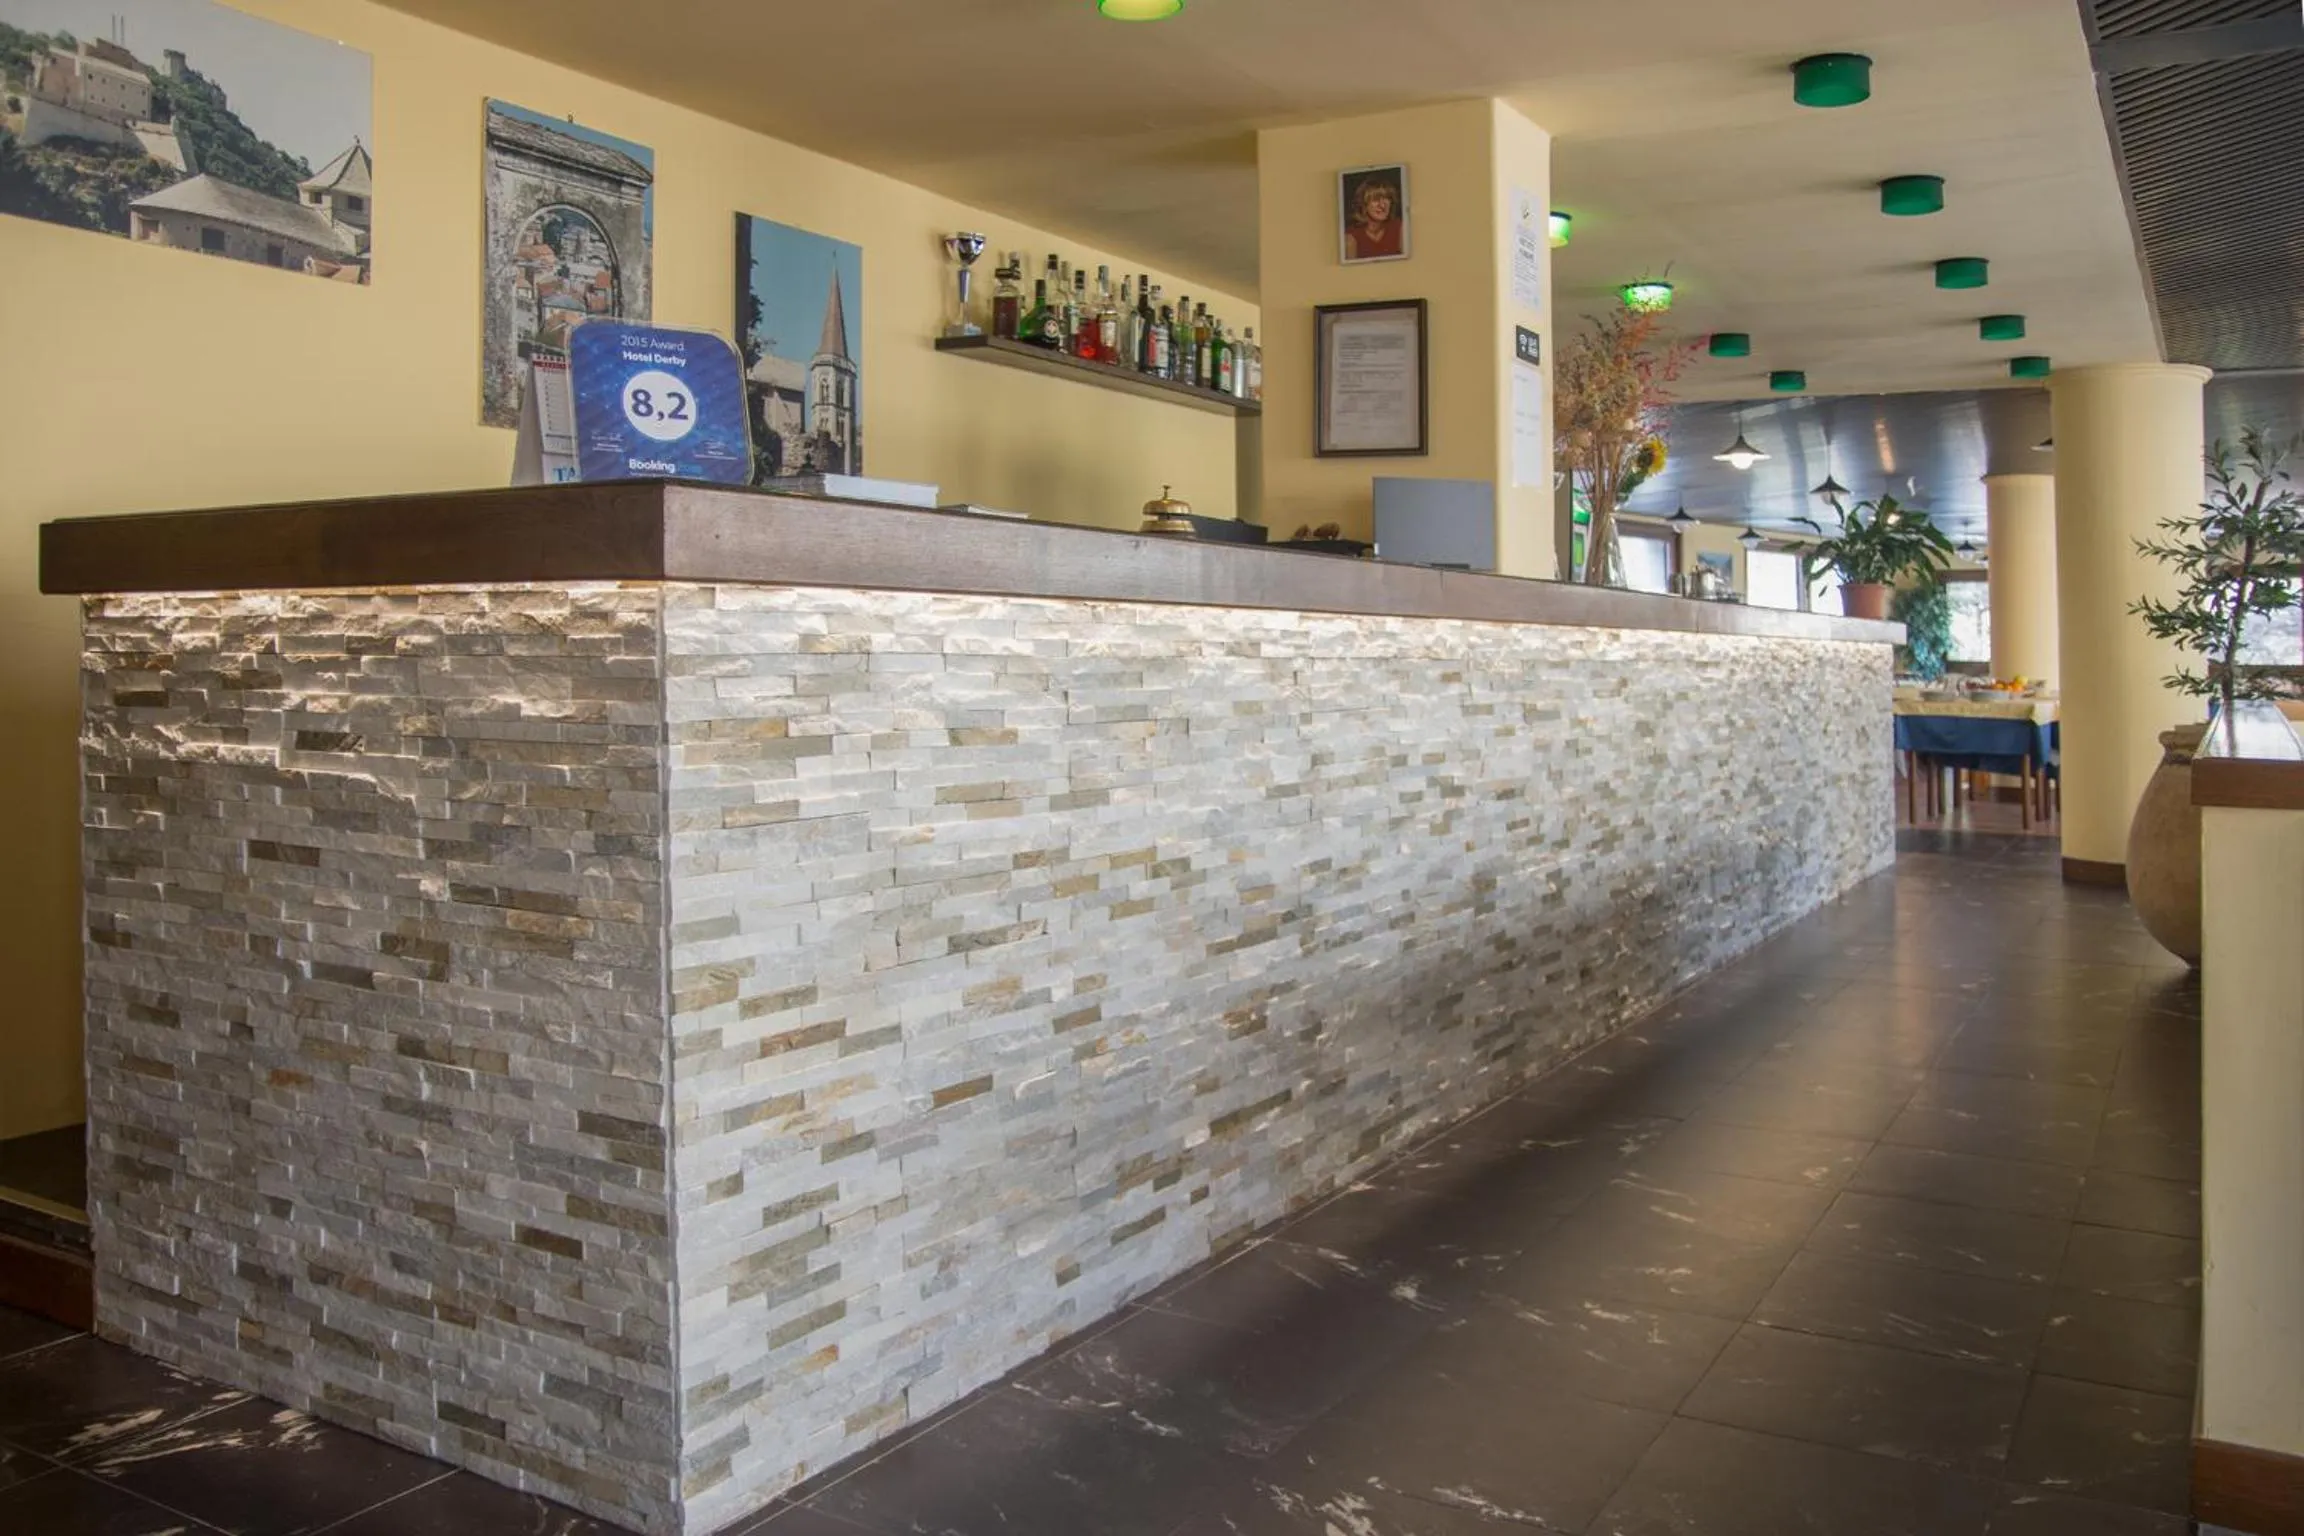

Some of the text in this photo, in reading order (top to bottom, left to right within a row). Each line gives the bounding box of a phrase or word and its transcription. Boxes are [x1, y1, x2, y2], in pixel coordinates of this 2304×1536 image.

[620, 335, 684, 352] 2015 Award
[622, 351, 687, 368] Hotel Derby
[631, 388, 688, 421] 8,2
